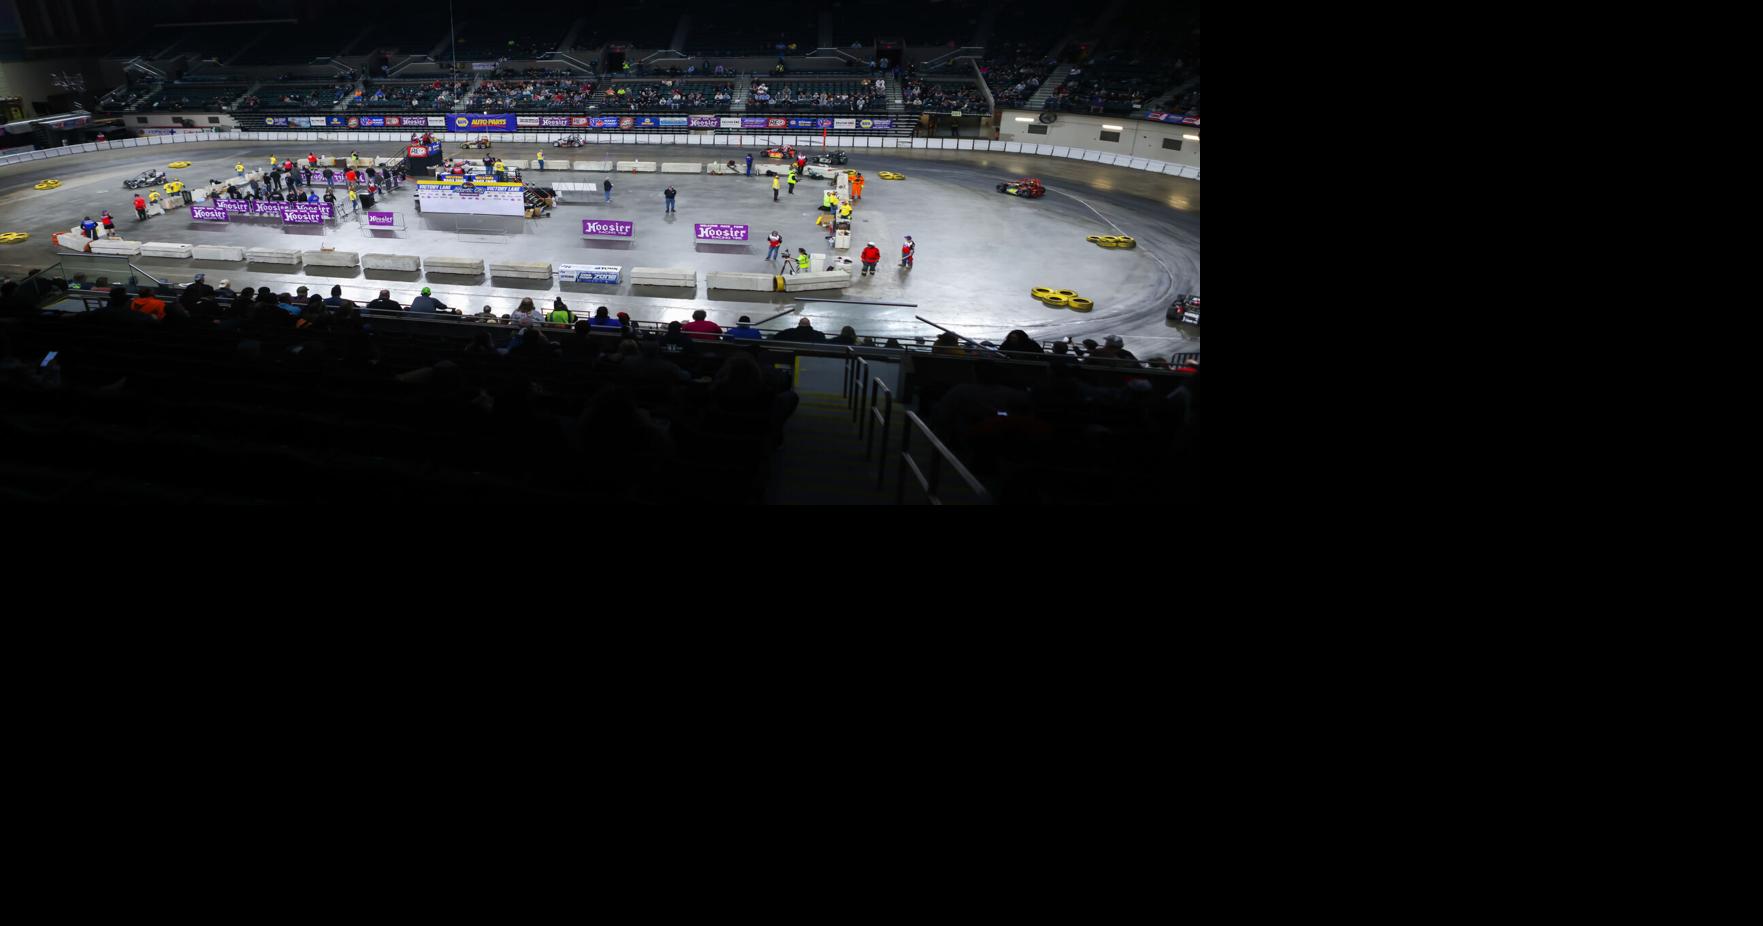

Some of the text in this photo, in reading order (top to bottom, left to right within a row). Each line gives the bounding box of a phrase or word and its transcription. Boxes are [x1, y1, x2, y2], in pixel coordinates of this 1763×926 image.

[690, 119, 718, 127] Hoosier
[193, 208, 226, 219] Hoosier
[284, 211, 320, 222] Hoosier
[369, 215, 393, 223] Hoosier
[585, 221, 631, 233] Hoosier
[697, 226, 747, 238] Hoosier
